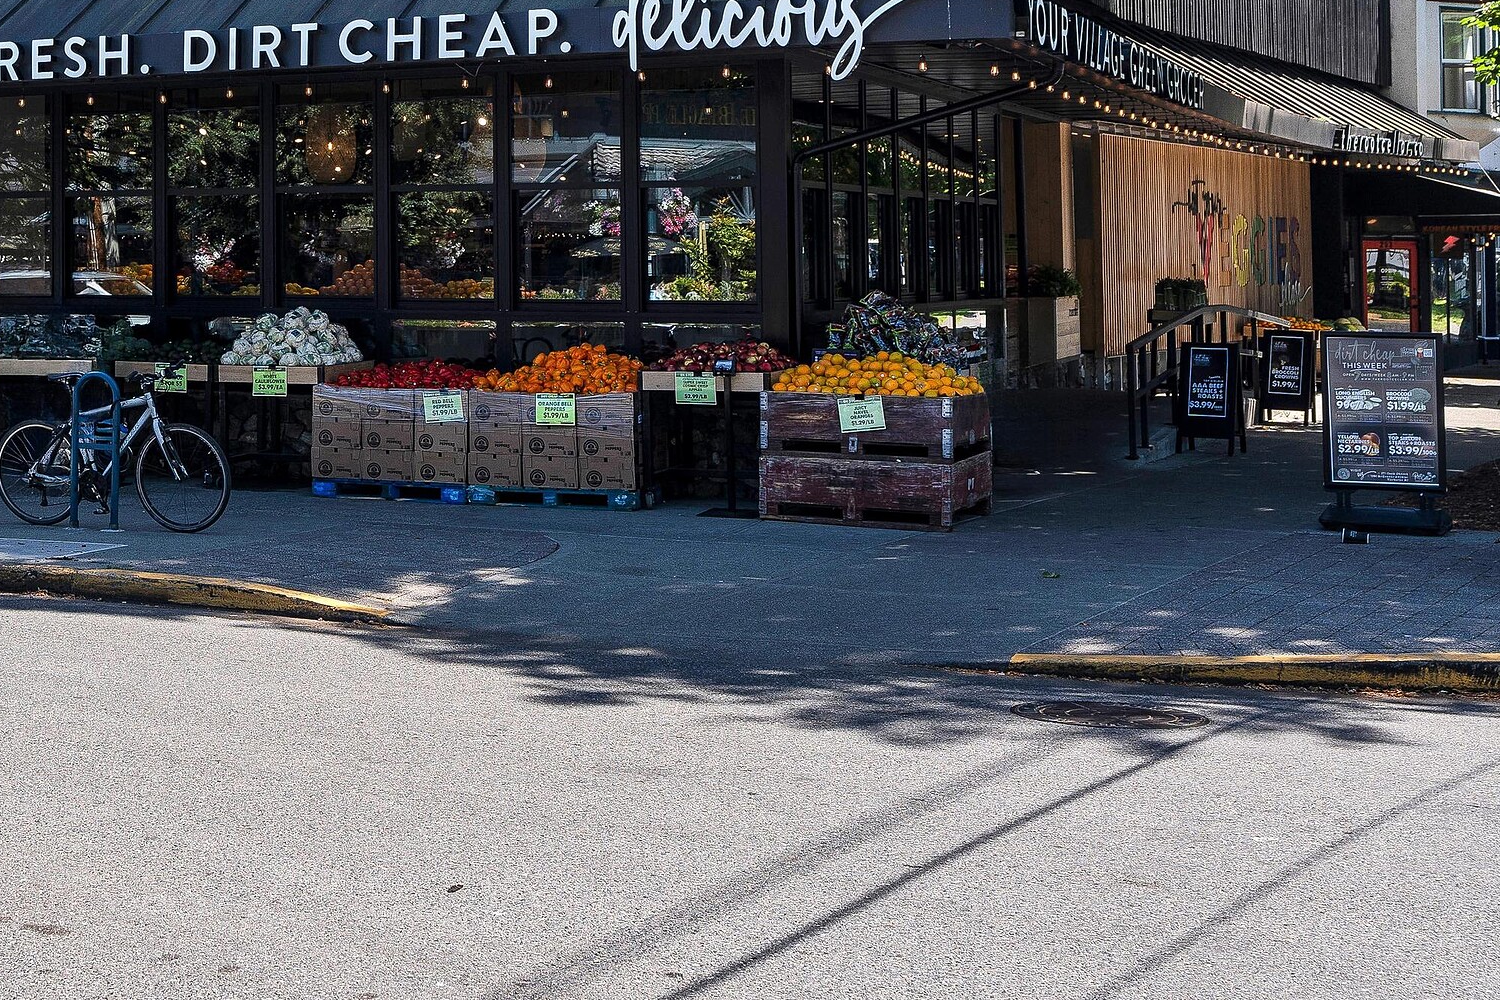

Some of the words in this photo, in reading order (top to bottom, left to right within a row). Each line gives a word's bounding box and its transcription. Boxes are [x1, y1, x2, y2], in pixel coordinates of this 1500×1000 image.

[183, 22, 318, 73] DIRT
[338, 8, 571, 63] CHEAP.
[1074, 12, 1126, 81] VILLAGE
[1129, 41, 1165, 95] GREEN
[1166, 59, 1205, 110] GROCER
[1196, 213, 1301, 289] VEGGIES
[1362, 341, 1402, 366] cheap
[431, 409, 458, 417] $1.99/LB
[543, 411, 569, 419] $1.99/LB
